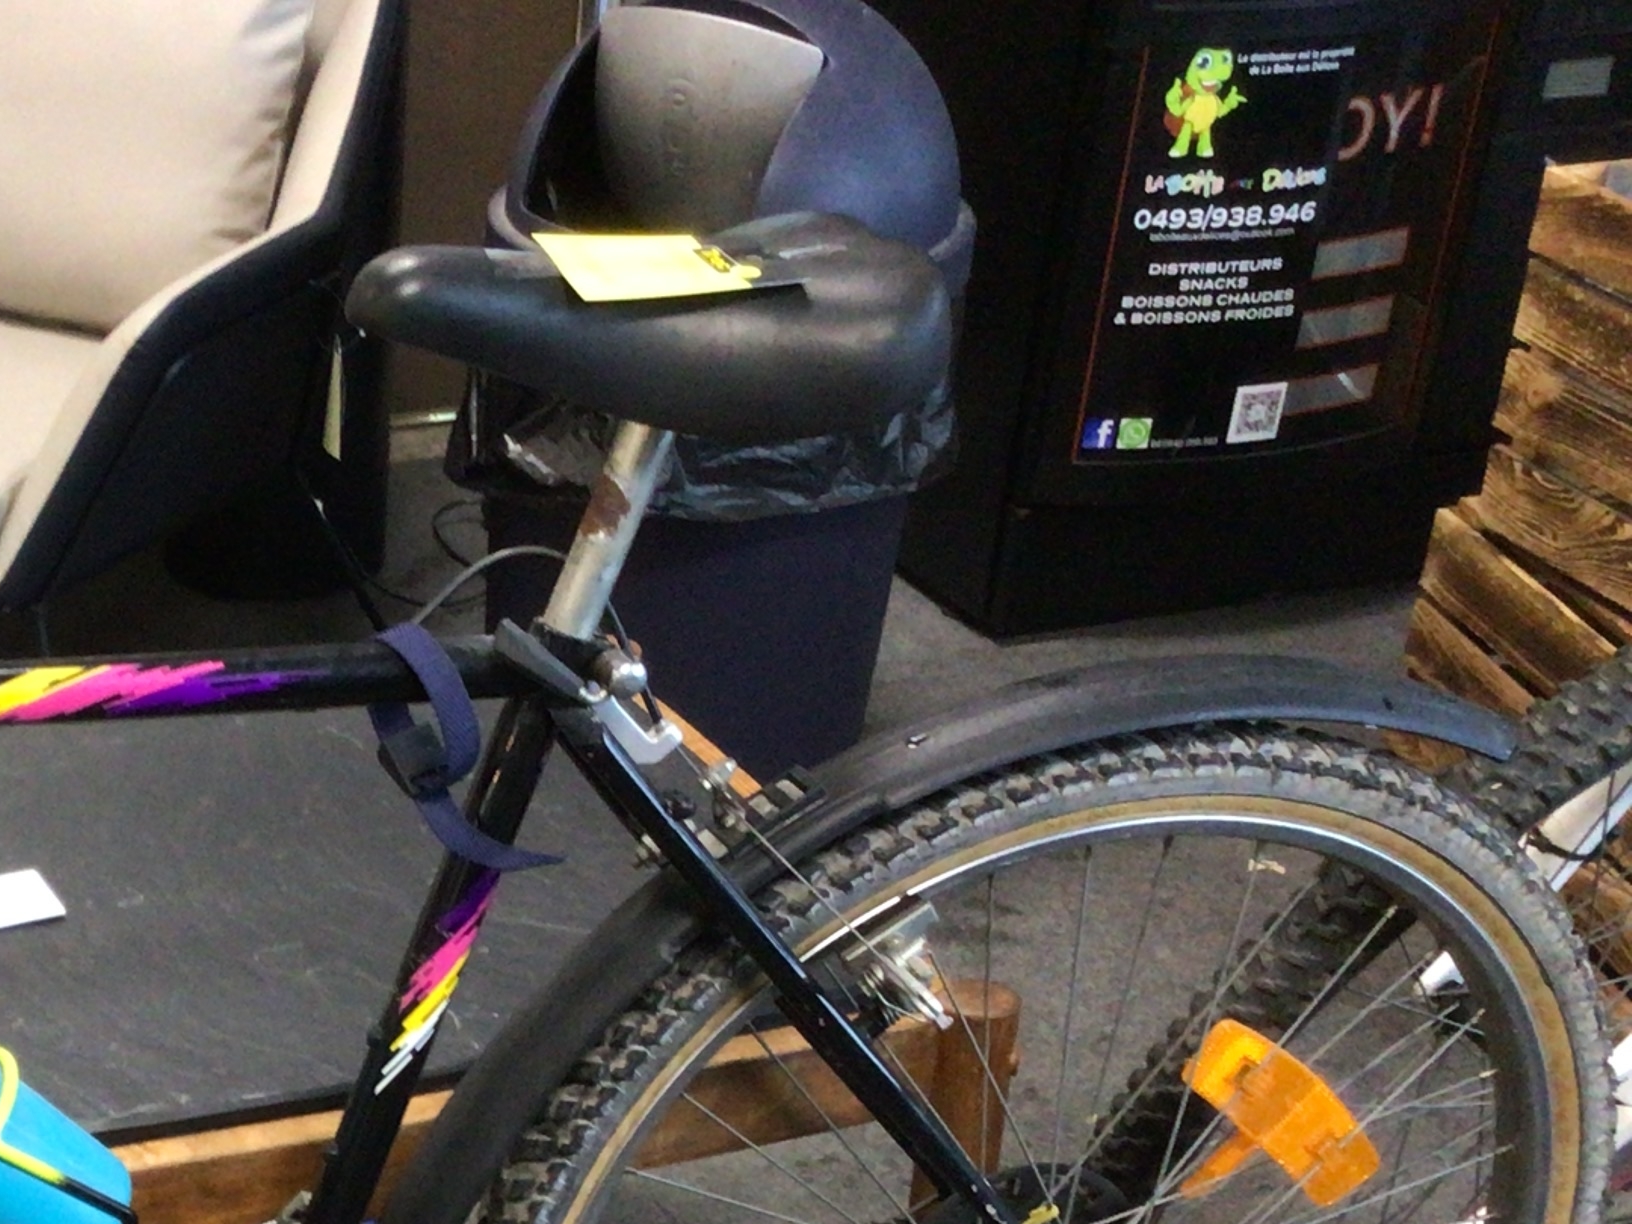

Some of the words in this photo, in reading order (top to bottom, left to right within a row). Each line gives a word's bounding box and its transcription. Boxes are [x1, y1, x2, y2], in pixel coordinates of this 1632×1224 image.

[1133, 200, 1317, 232] 0493/938.946
[1148, 257, 1283, 276] DISTRIBUTEURS
[1179, 277, 1249, 291] SNACKS
[1121, 295, 1213, 309] BOISSONS
[1216, 288, 1295, 305] CHAUDES
[1113, 312, 1126, 326] &
[1130, 310, 1221, 325] BOISSONS
[1224, 304, 1295, 322] FROIDES
